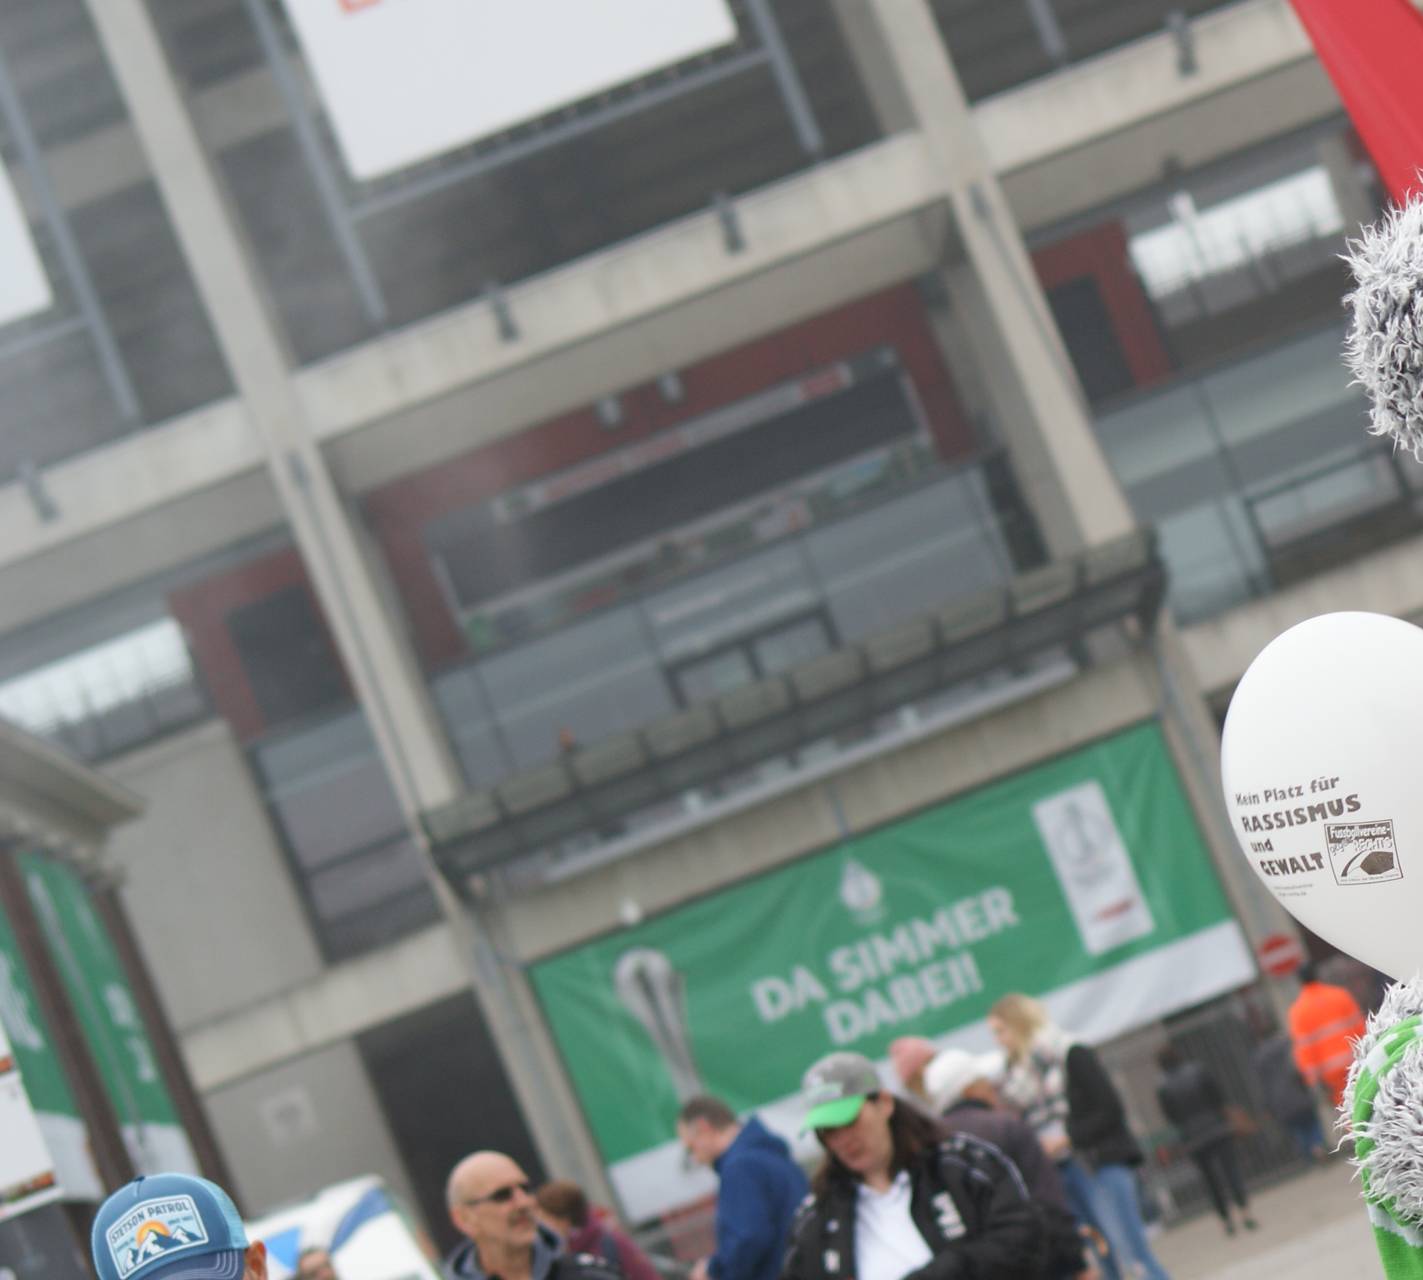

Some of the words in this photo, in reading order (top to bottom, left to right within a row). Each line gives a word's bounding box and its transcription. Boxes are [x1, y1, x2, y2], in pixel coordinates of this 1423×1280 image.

[1235, 793, 1260, 806] Kein
[1264, 785, 1304, 803] Platz
[1310, 776, 1340, 793] für
[1241, 794, 1361, 832] RASSISMUS
[1250, 838, 1274, 853] und
[1260, 852, 1325, 876] GEWALT
[753, 965, 828, 1022] DA
[830, 887, 1020, 992] SIMMER
[112, 1212, 145, 1242] STETSON
[147, 1202, 189, 1217] PATROL
